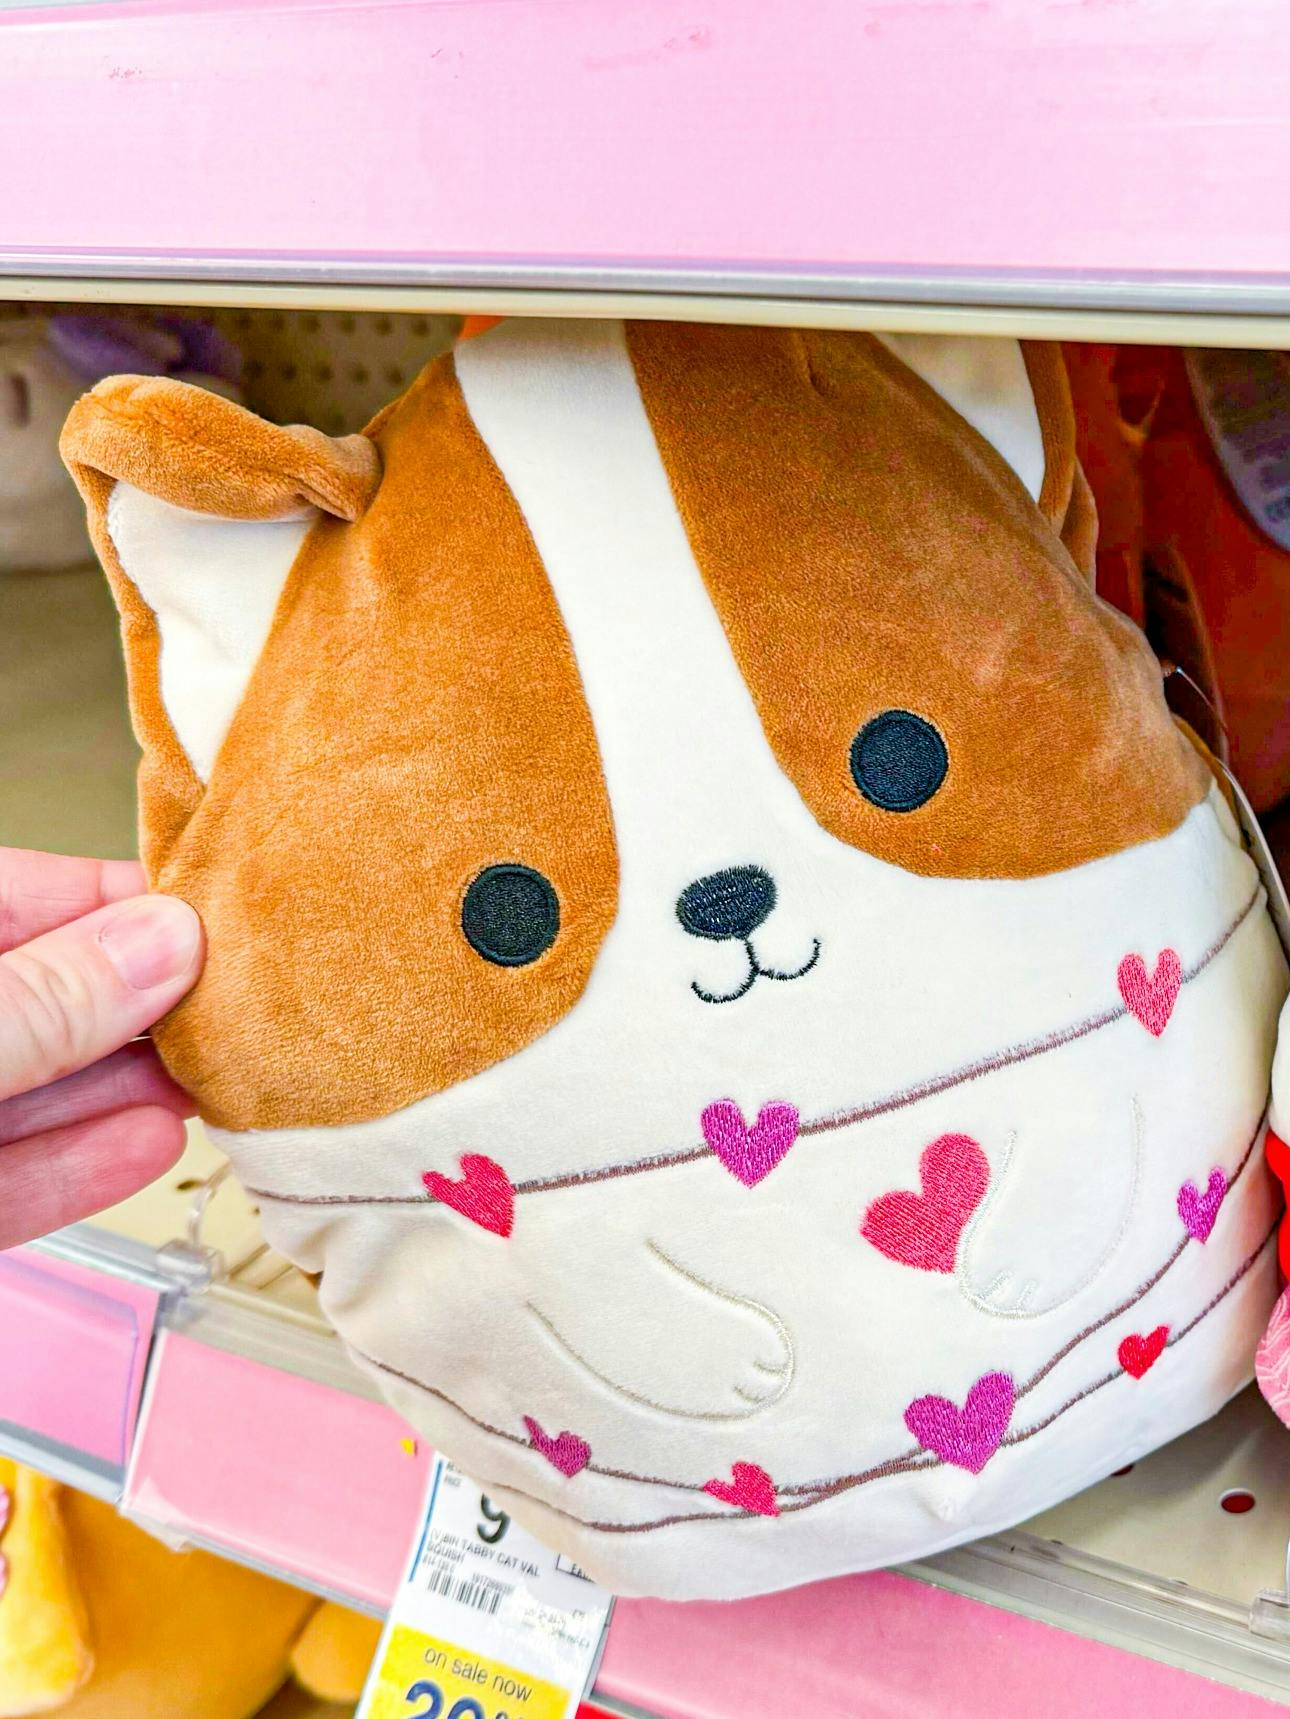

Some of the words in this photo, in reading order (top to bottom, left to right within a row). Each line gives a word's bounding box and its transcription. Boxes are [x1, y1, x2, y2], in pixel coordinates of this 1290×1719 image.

[462, 1539, 496, 1560] TABBY
[497, 1552, 520, 1569] CAT
[520, 1560, 541, 1577] VAL
[424, 1648, 448, 1669] on
[451, 1658, 488, 1685] sale
[492, 1674, 533, 1702] now
